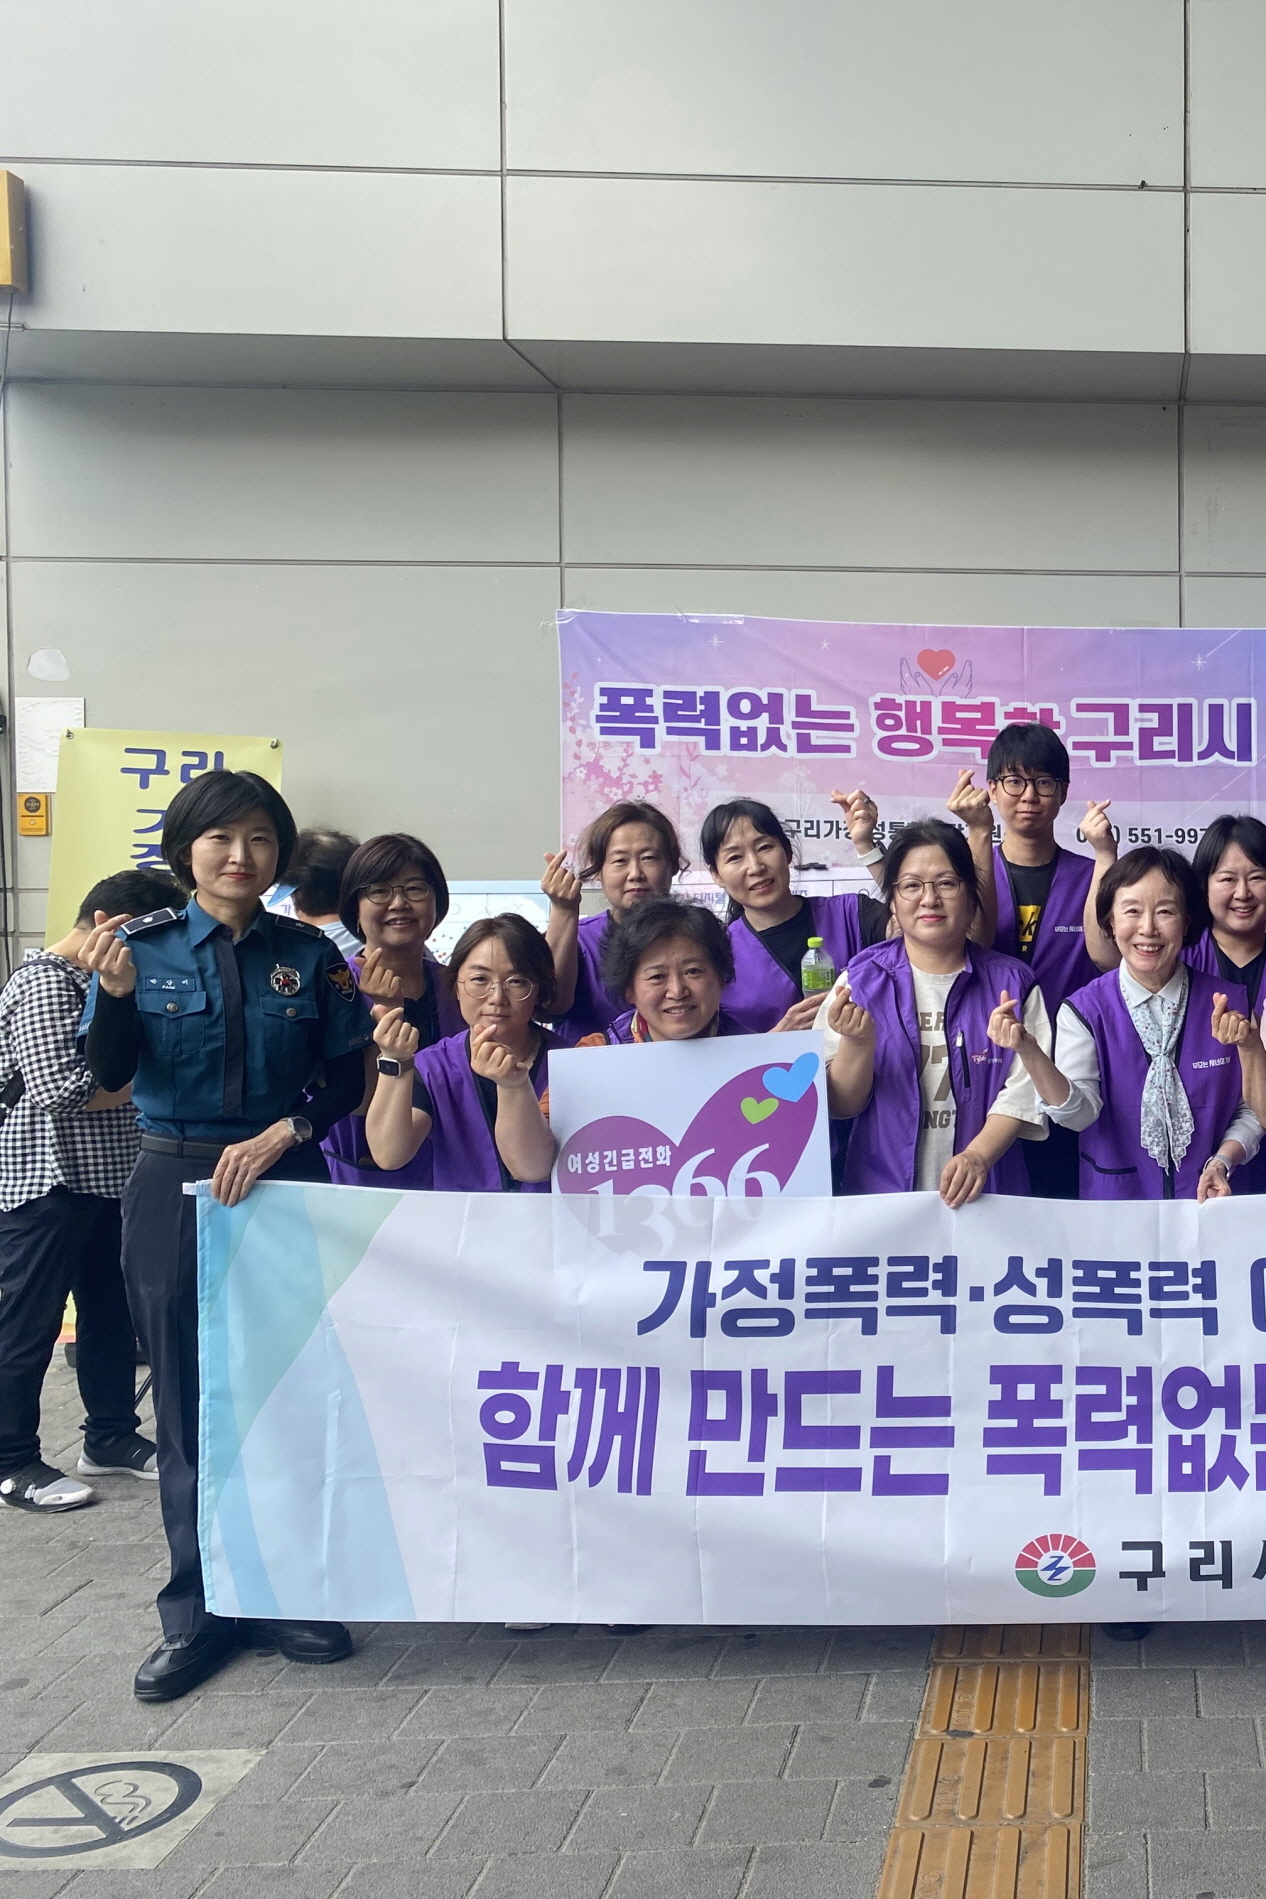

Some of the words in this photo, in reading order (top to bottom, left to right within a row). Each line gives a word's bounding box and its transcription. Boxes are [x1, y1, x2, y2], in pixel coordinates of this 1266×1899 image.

[596, 686, 855, 754] 폭력없는
[1072, 703, 1253, 762] 구리시
[567, 1145, 672, 1175] 여성긴급전화
[477, 1361, 661, 1496] 함께
[686, 1365, 955, 1497] 만드는
